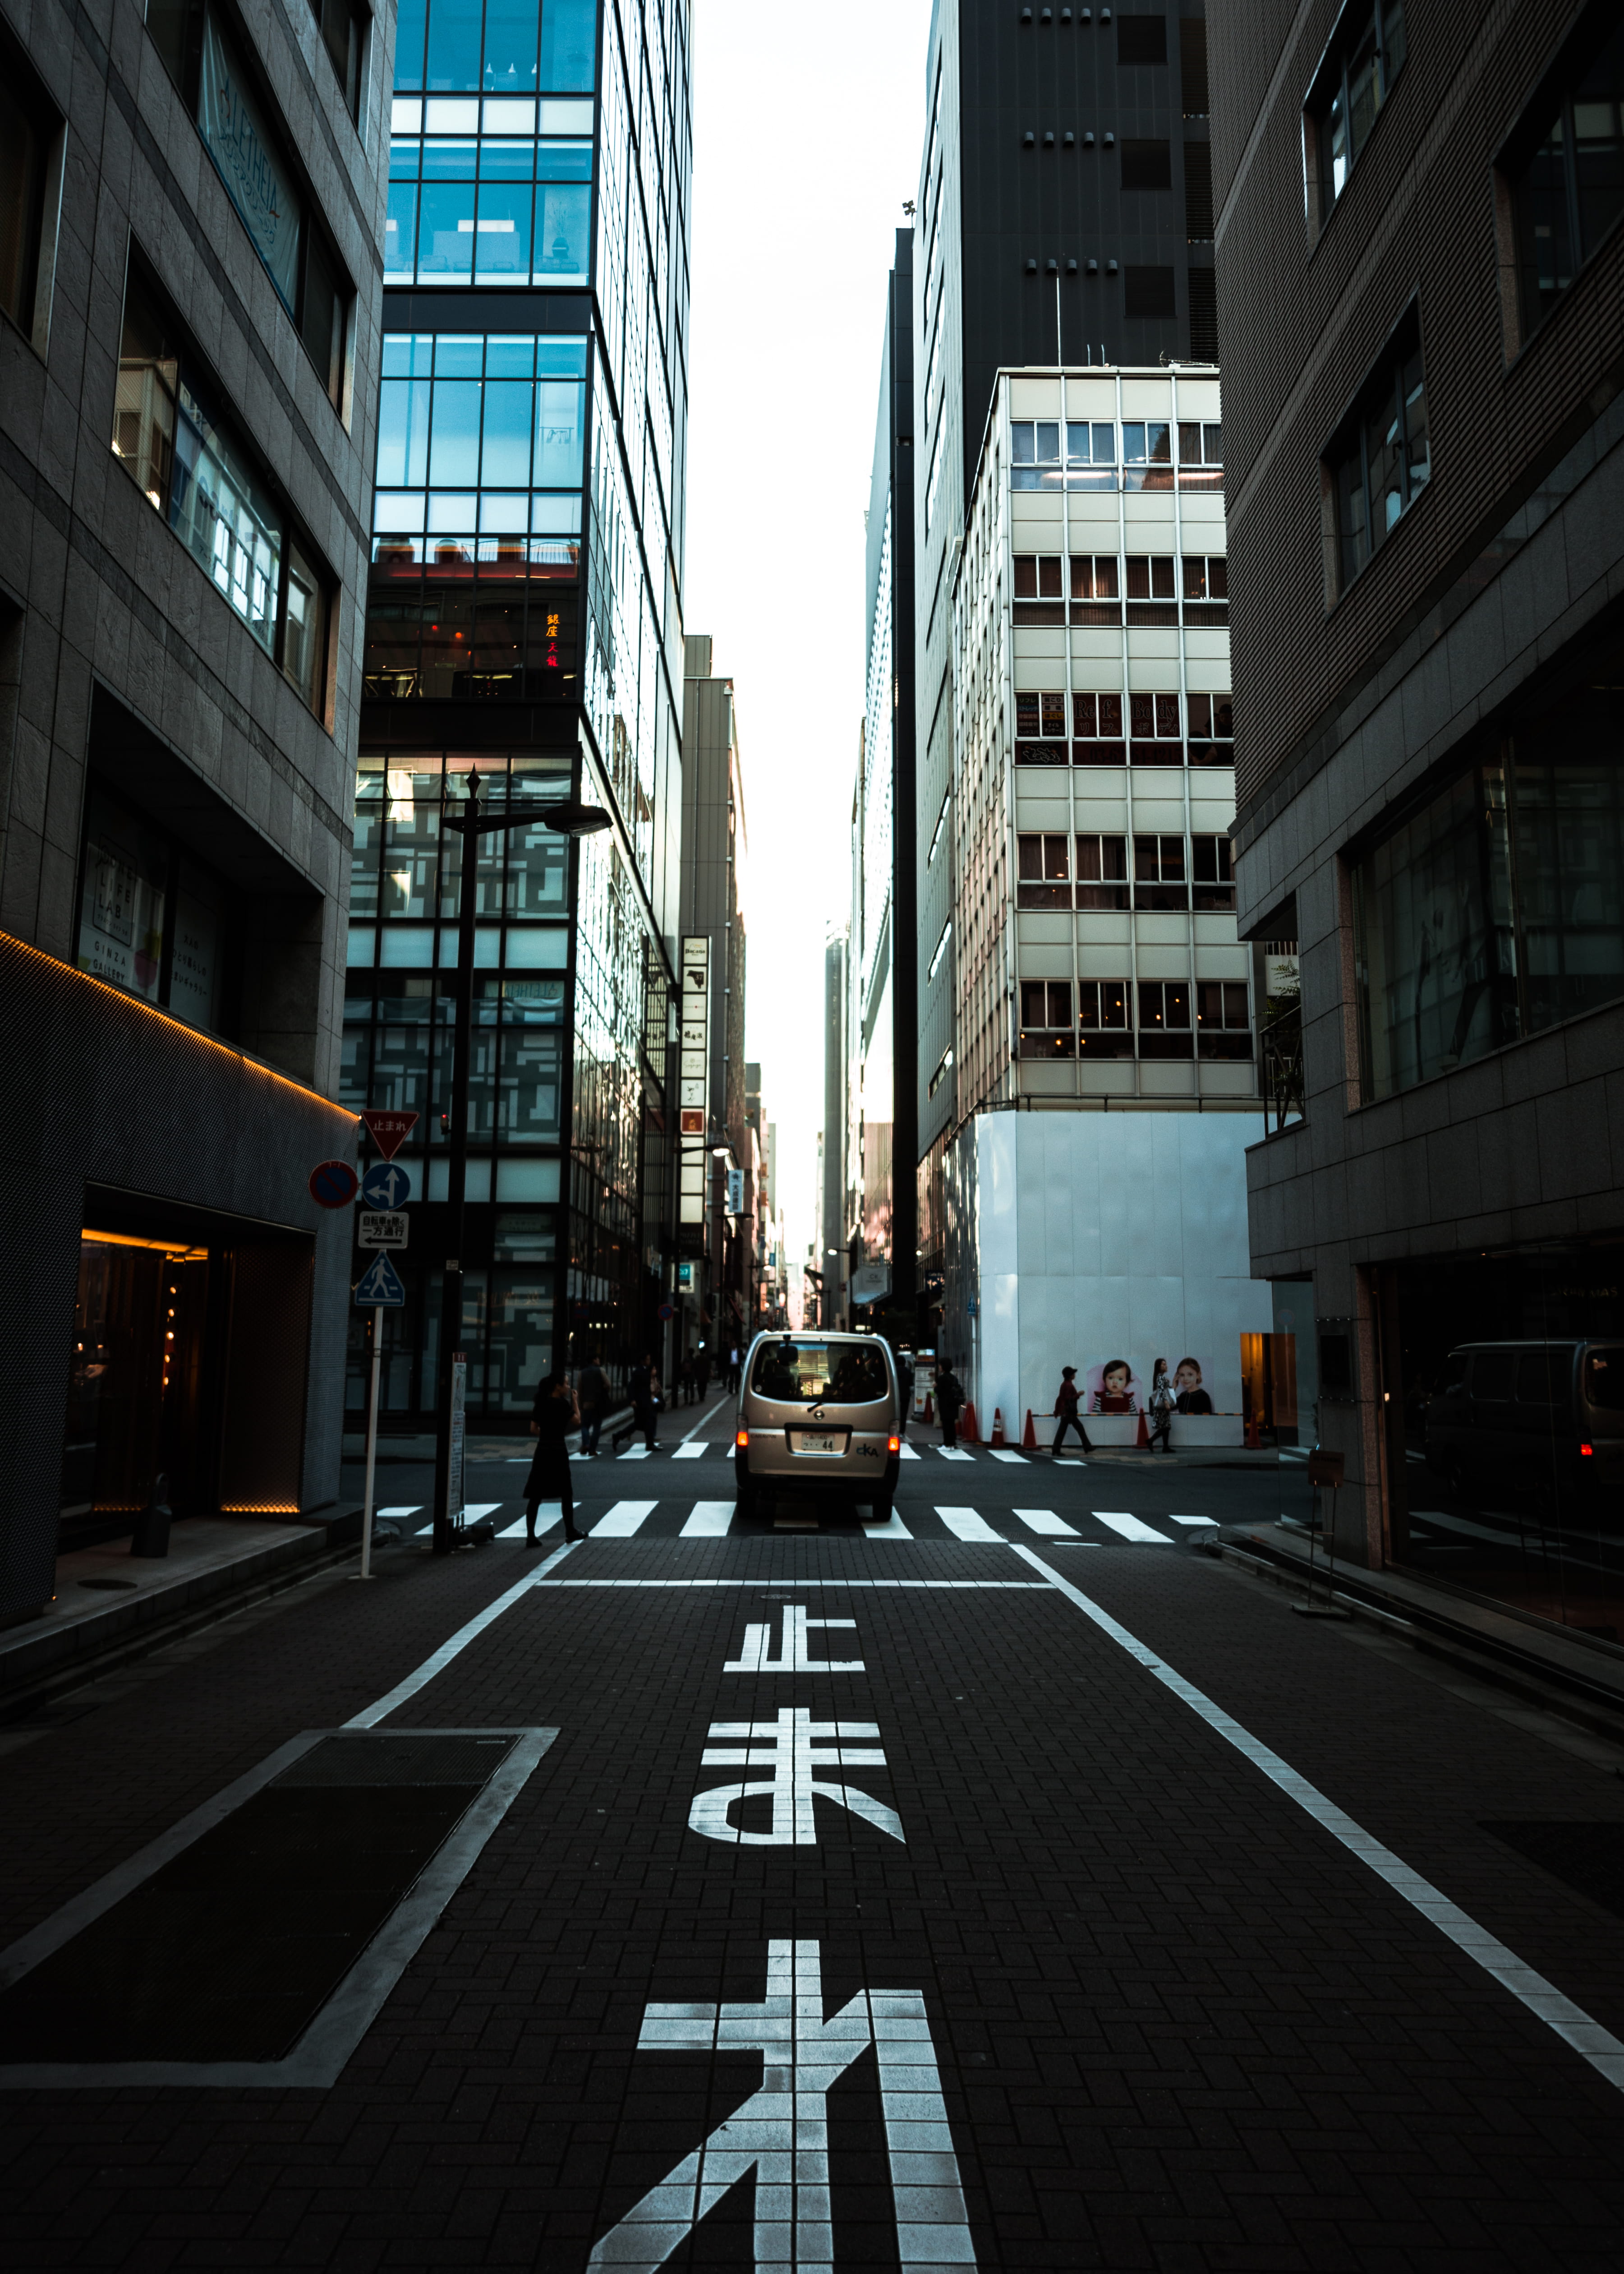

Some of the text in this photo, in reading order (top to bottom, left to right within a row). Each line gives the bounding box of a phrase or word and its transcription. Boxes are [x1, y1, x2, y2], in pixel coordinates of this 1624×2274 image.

[221, 77, 280, 228] ALETHEIA
[546, 614, 560, 667] 銀座 天龍
[1132, 700, 1177, 722] Body
[98, 893, 121, 918] LAB
[95, 941, 126, 967] GINZA
[93, 959, 125, 983] GALLERY
[373, 1119, 406, 1132] 止まれ
[363, 1216, 405, 1226] 自転車を除く
[363, 1227, 404, 1236] 一方通行
[586, 1605, 977, 2274] 止まれ
